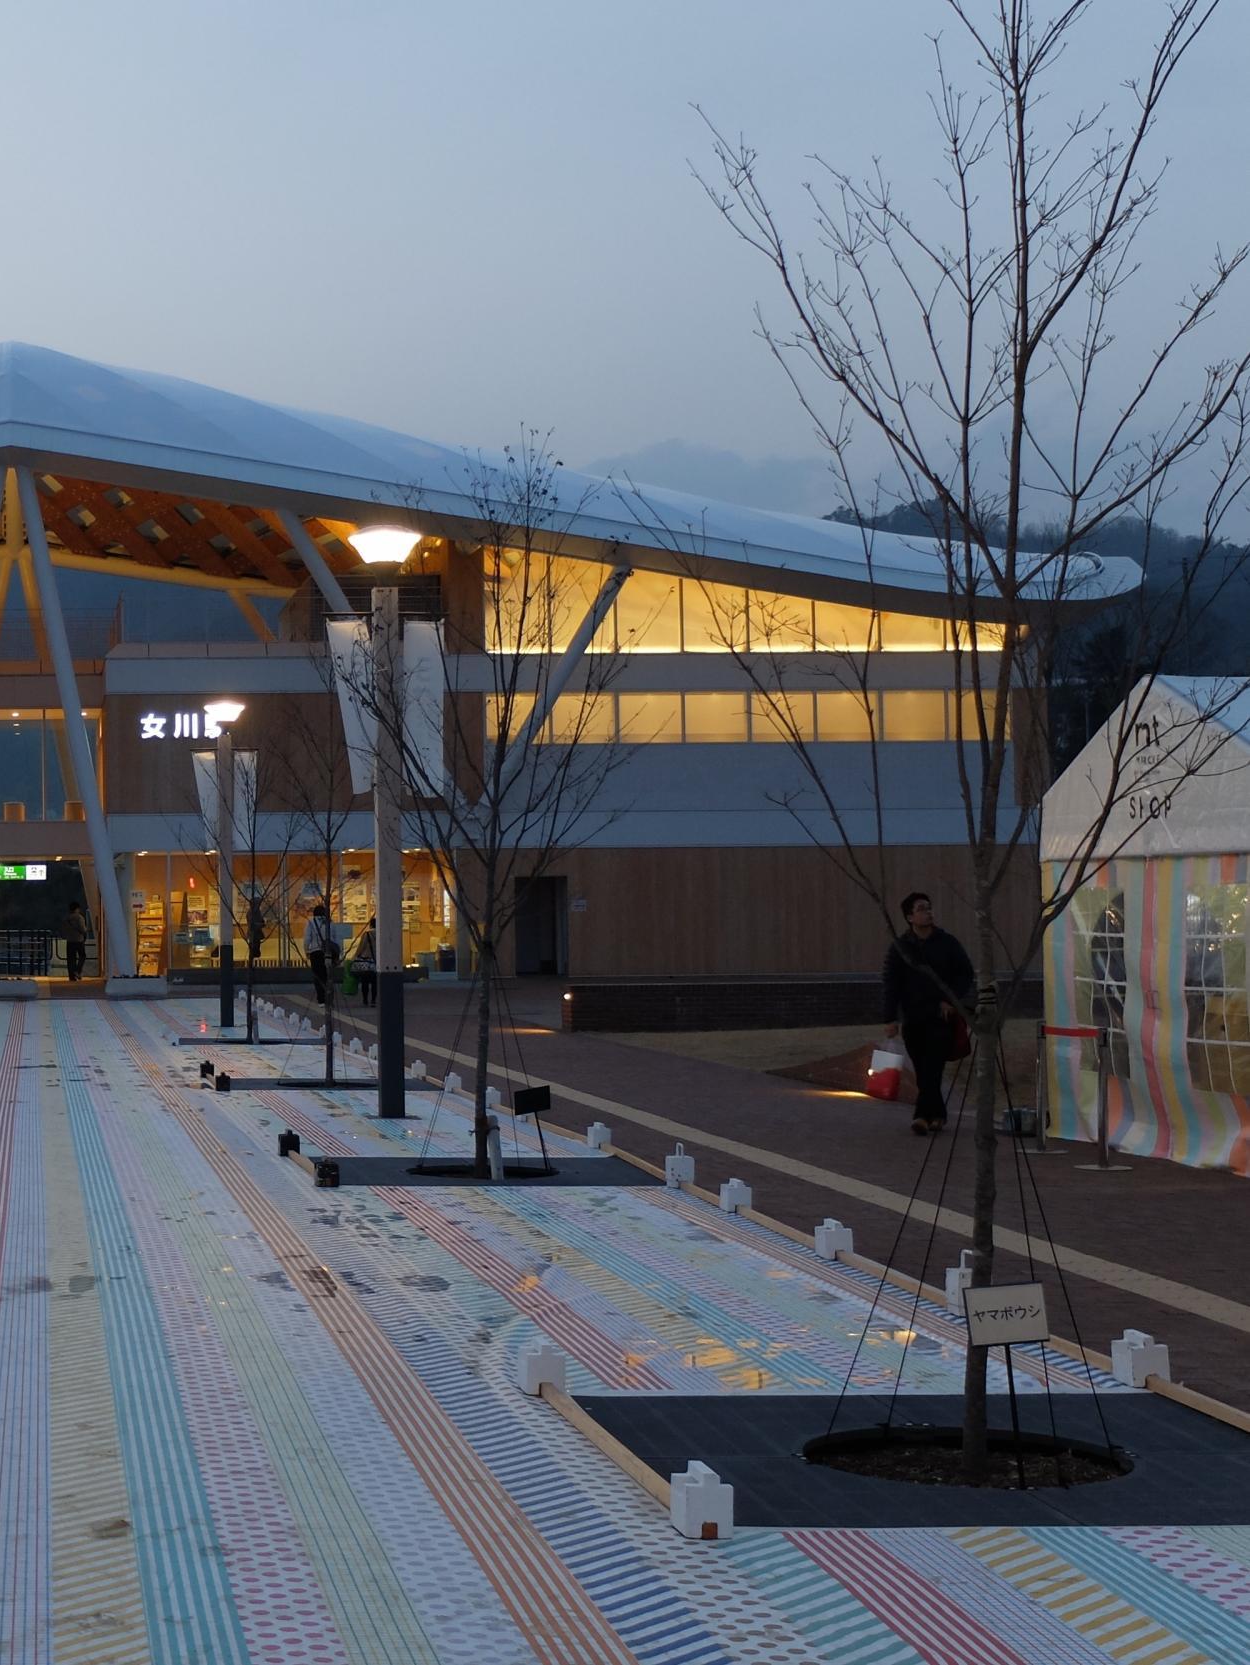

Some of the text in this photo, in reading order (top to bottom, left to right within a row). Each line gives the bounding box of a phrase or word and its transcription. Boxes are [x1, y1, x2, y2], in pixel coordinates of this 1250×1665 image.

[973, 1305, 1040, 1322] ヤマボウシ
